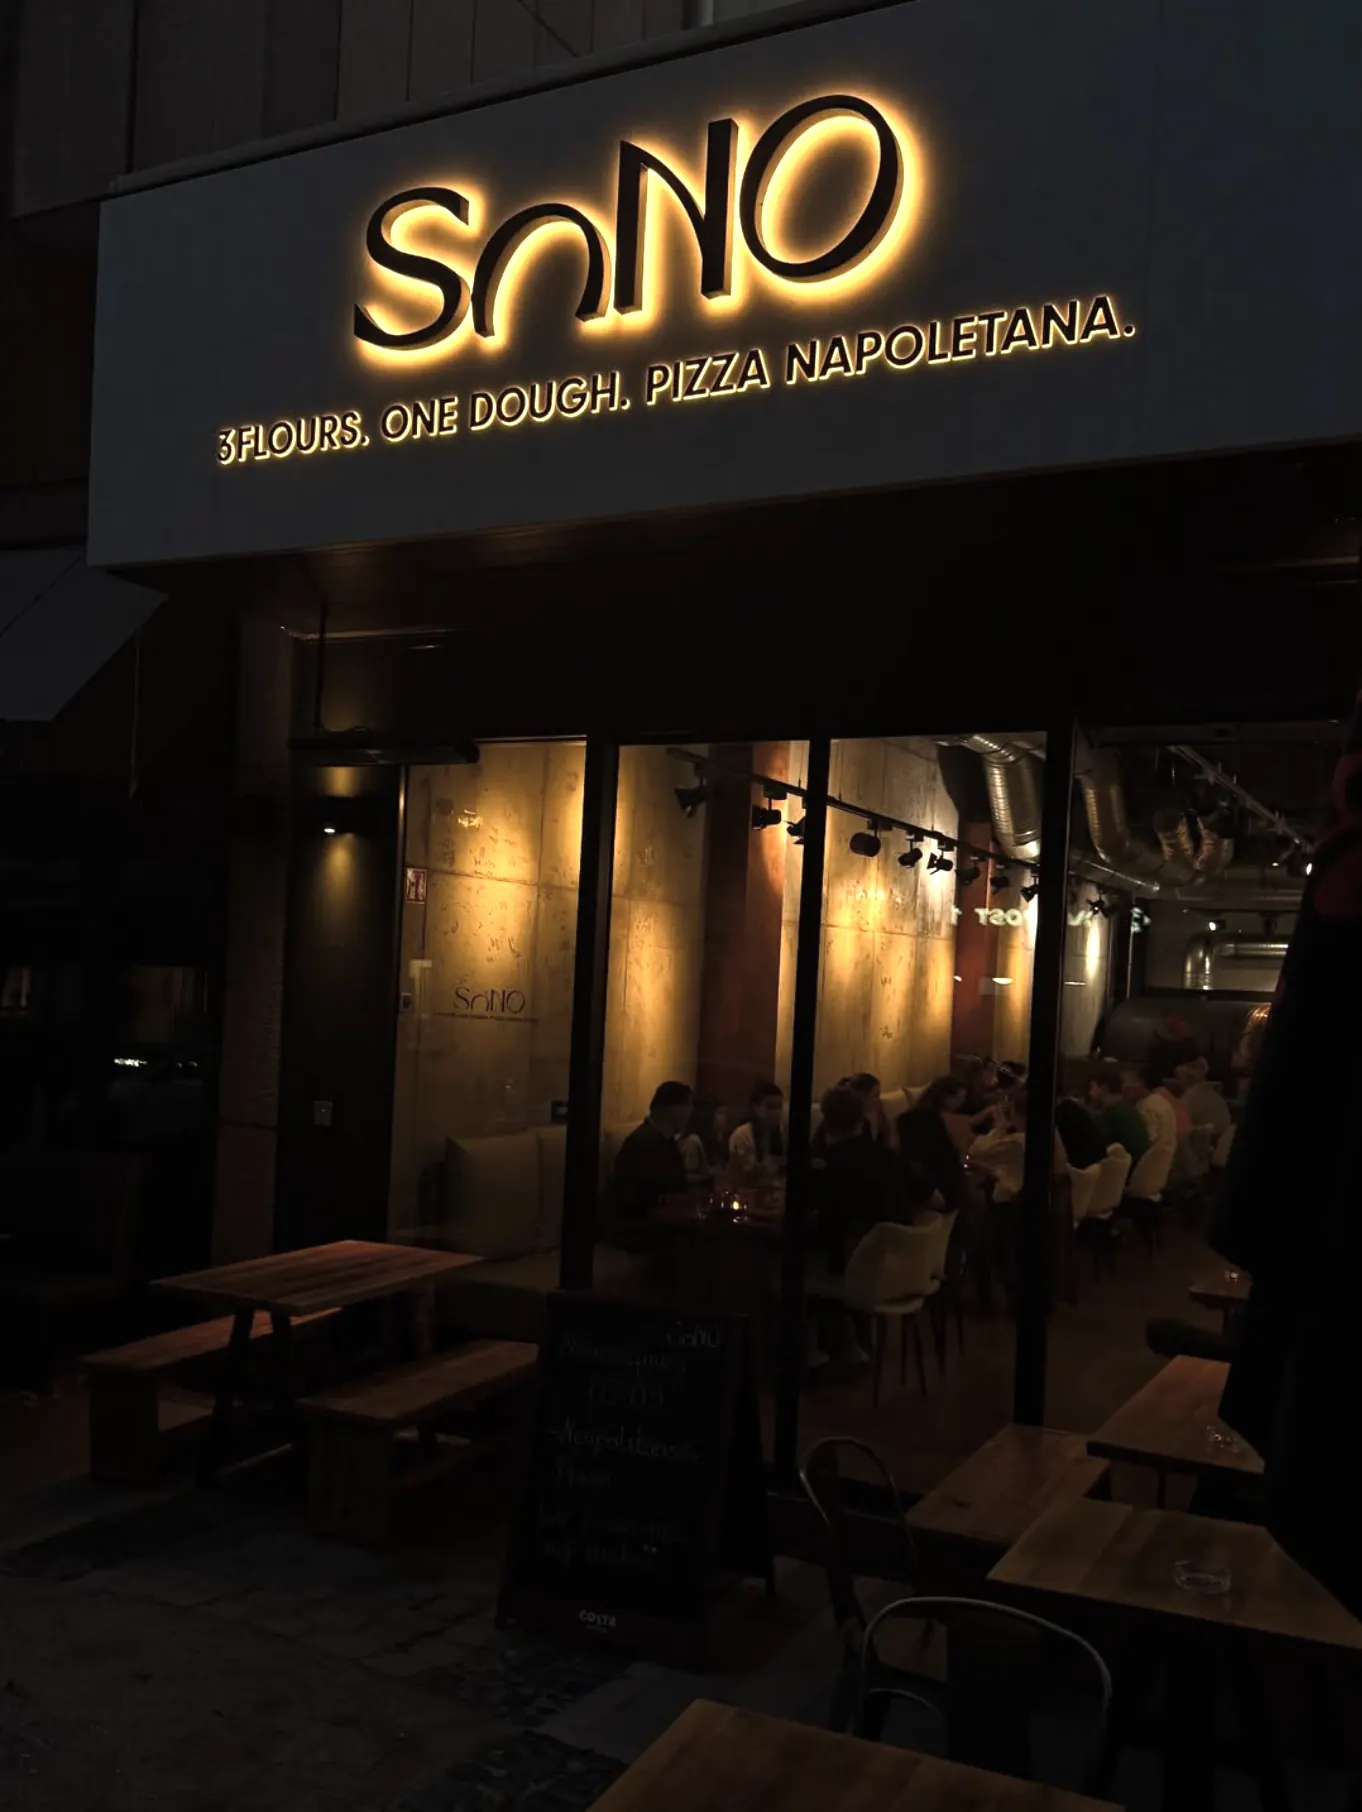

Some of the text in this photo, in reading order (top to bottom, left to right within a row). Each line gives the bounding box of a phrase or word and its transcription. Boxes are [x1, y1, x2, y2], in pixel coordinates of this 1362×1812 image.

[381, 396, 459, 442] ONE
[469, 371, 631, 430] DOUGH.
[646, 348, 770, 405] PIZZA
[786, 296, 1136, 384] NAPOLETANA.
